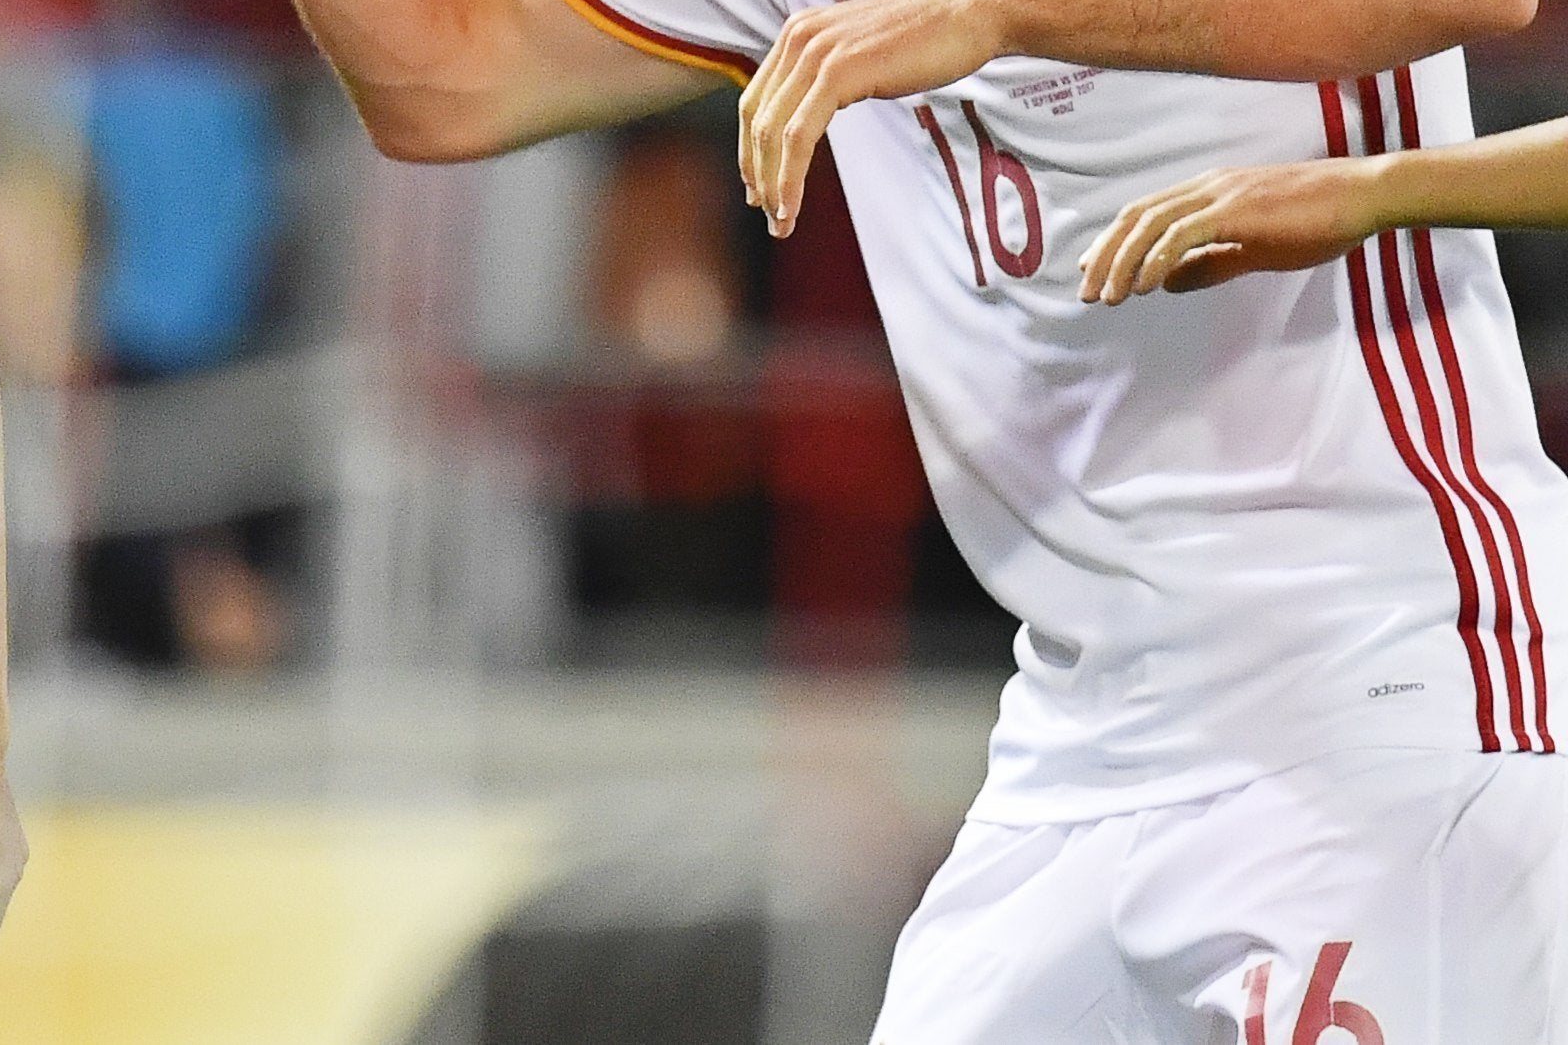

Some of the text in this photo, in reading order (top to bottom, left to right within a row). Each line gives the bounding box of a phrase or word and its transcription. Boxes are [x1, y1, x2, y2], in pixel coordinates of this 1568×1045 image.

[914, 100, 1043, 287] 16
[1368, 683, 1425, 698] adizero
[1241, 941, 1385, 1045] 16
